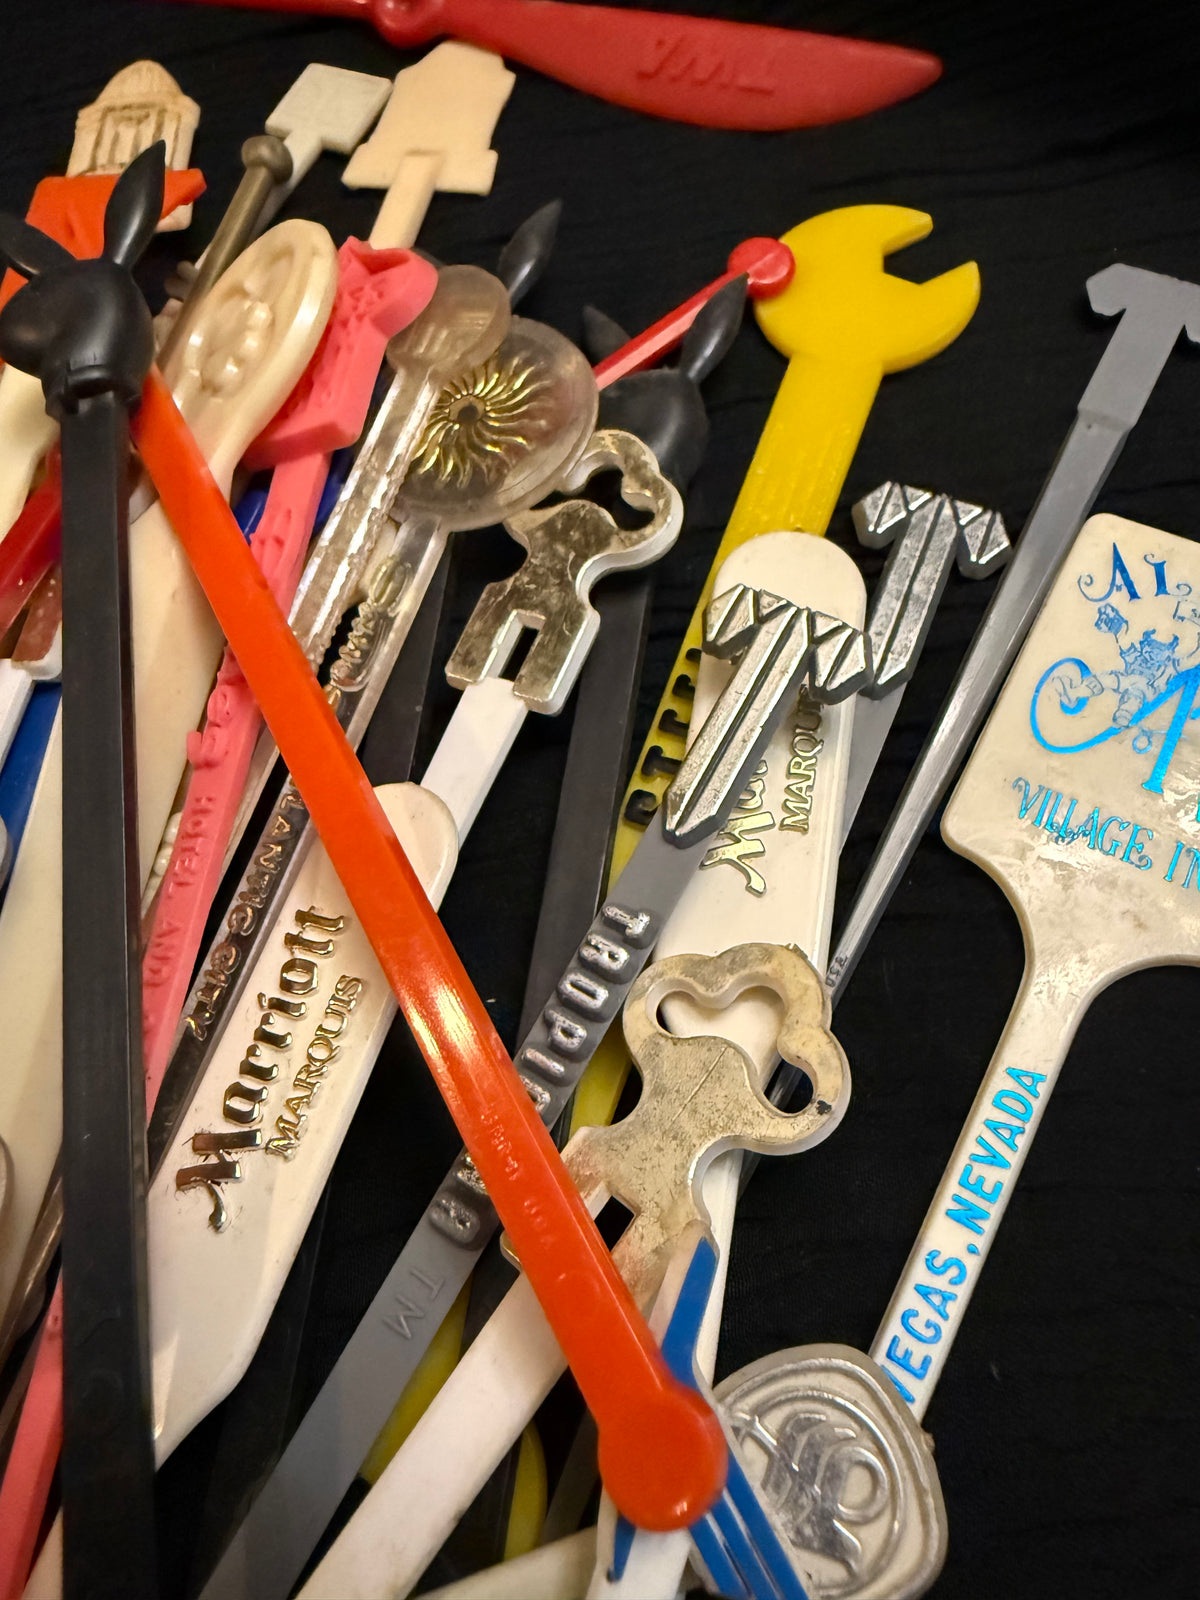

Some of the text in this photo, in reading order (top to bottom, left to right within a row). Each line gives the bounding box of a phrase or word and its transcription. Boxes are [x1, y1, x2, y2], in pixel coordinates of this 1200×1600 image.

[229, 780, 307, 936] LANTIC
[1012, 776, 1154, 870] VILLAGE
[174, 903, 346, 1235] Marriott
[265, 974, 364, 1160] MARQUIS
[945, 1066, 1048, 1237] NEVADA
[383, 1266, 446, 1341] TM
